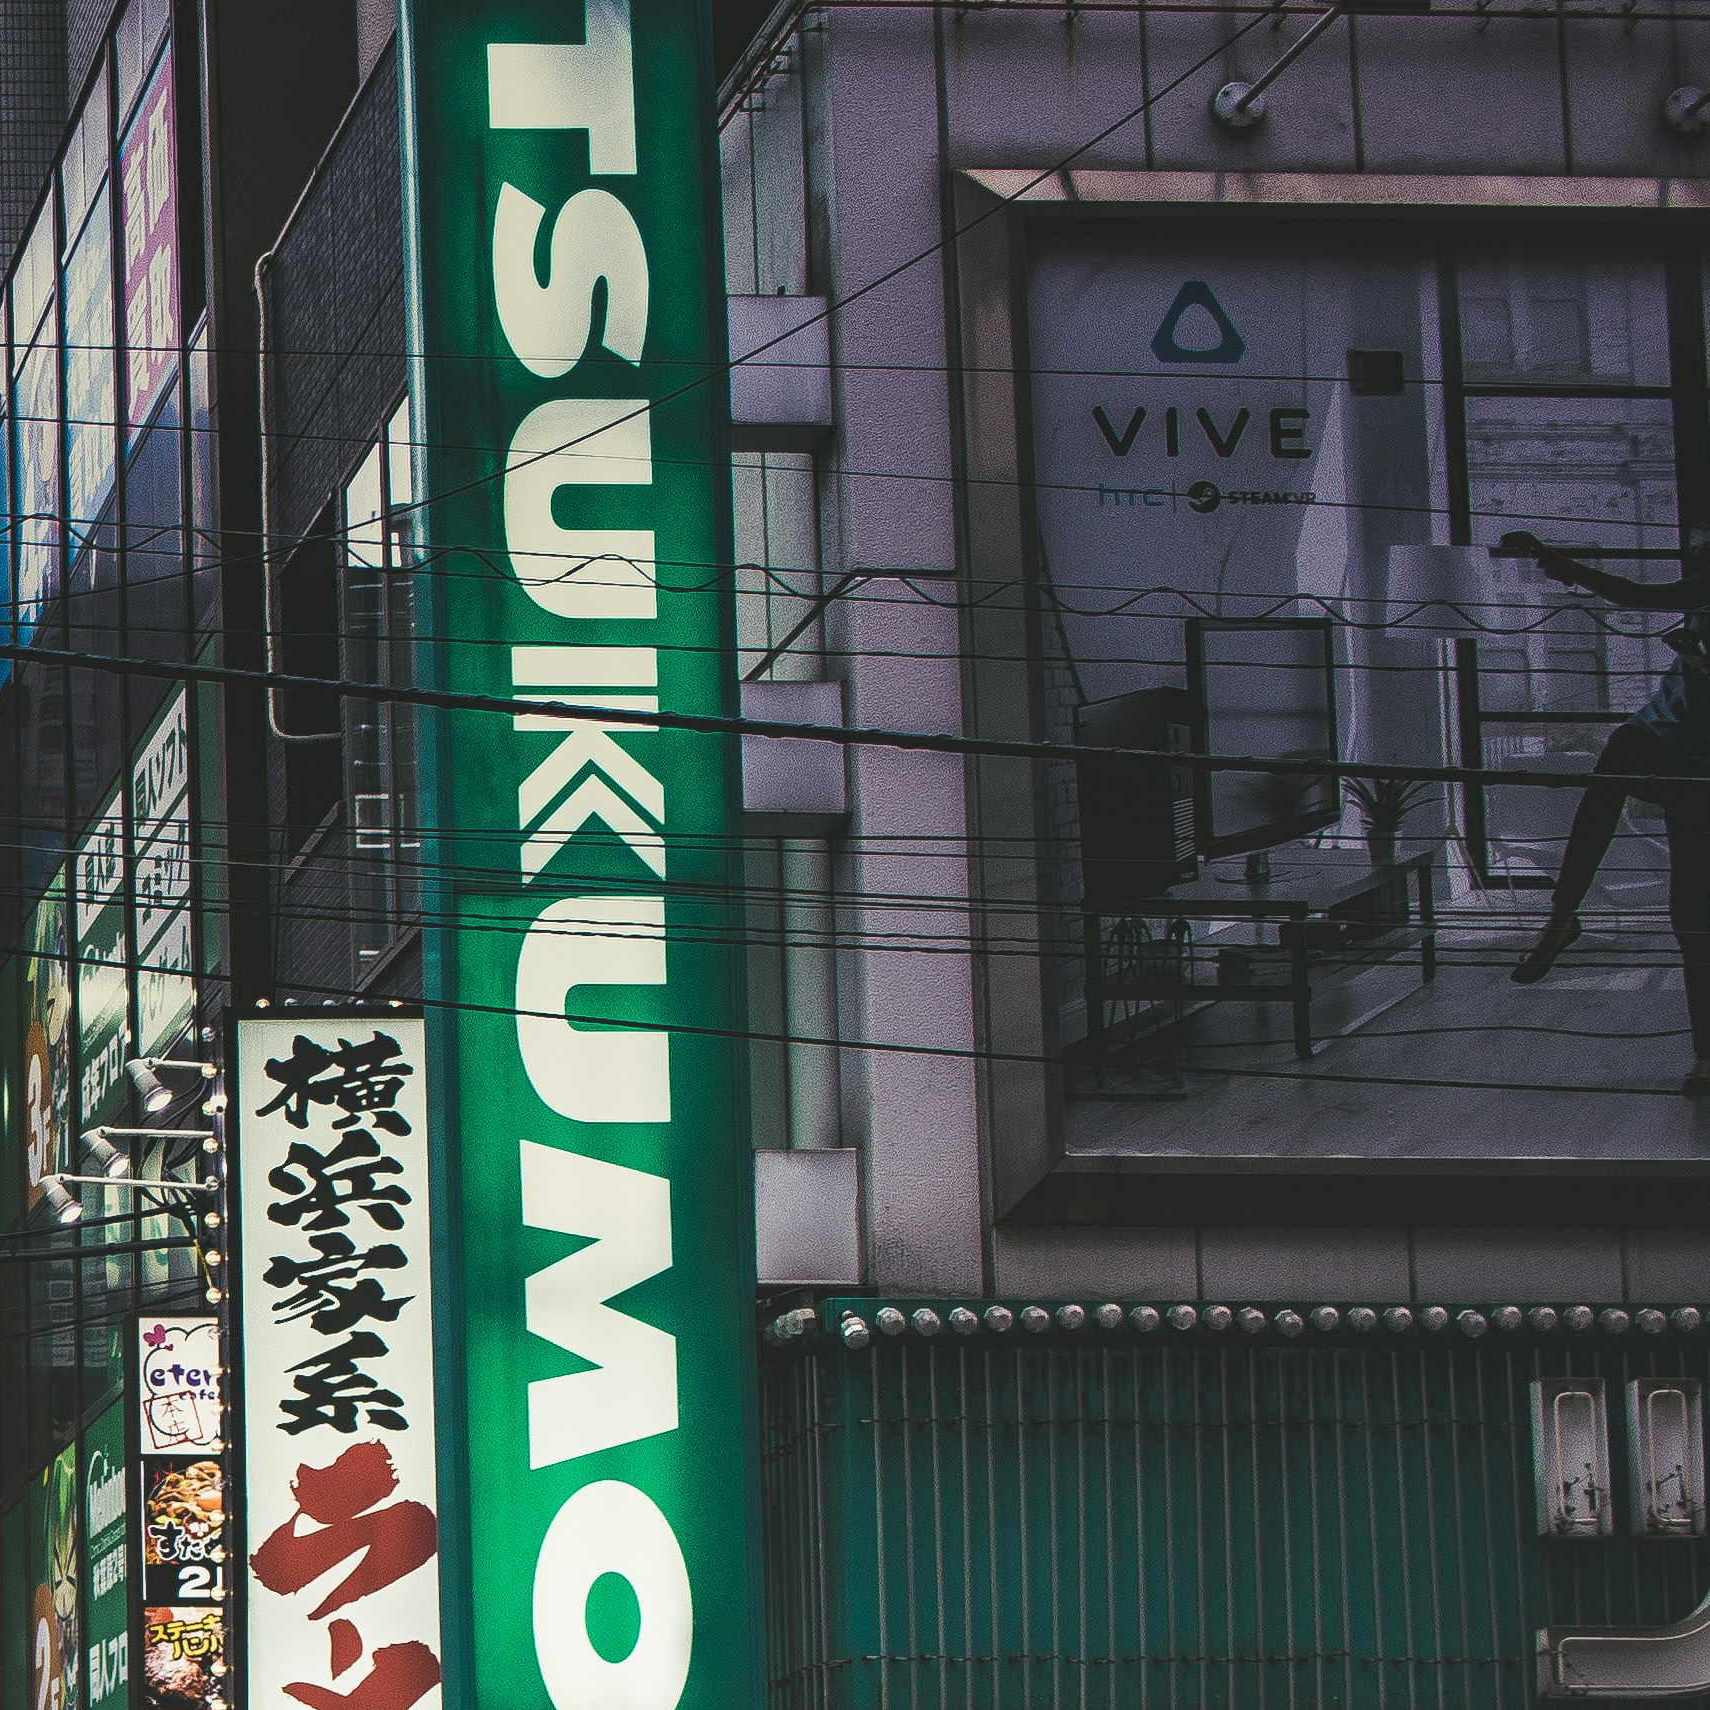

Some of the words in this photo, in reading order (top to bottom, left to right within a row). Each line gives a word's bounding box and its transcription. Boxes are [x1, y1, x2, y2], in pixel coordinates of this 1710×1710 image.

[1091, 406, 1314, 460] VIVE
[1098, 484, 1164, 509] htc
[256, 1032, 416, 1438] 横浜家系
